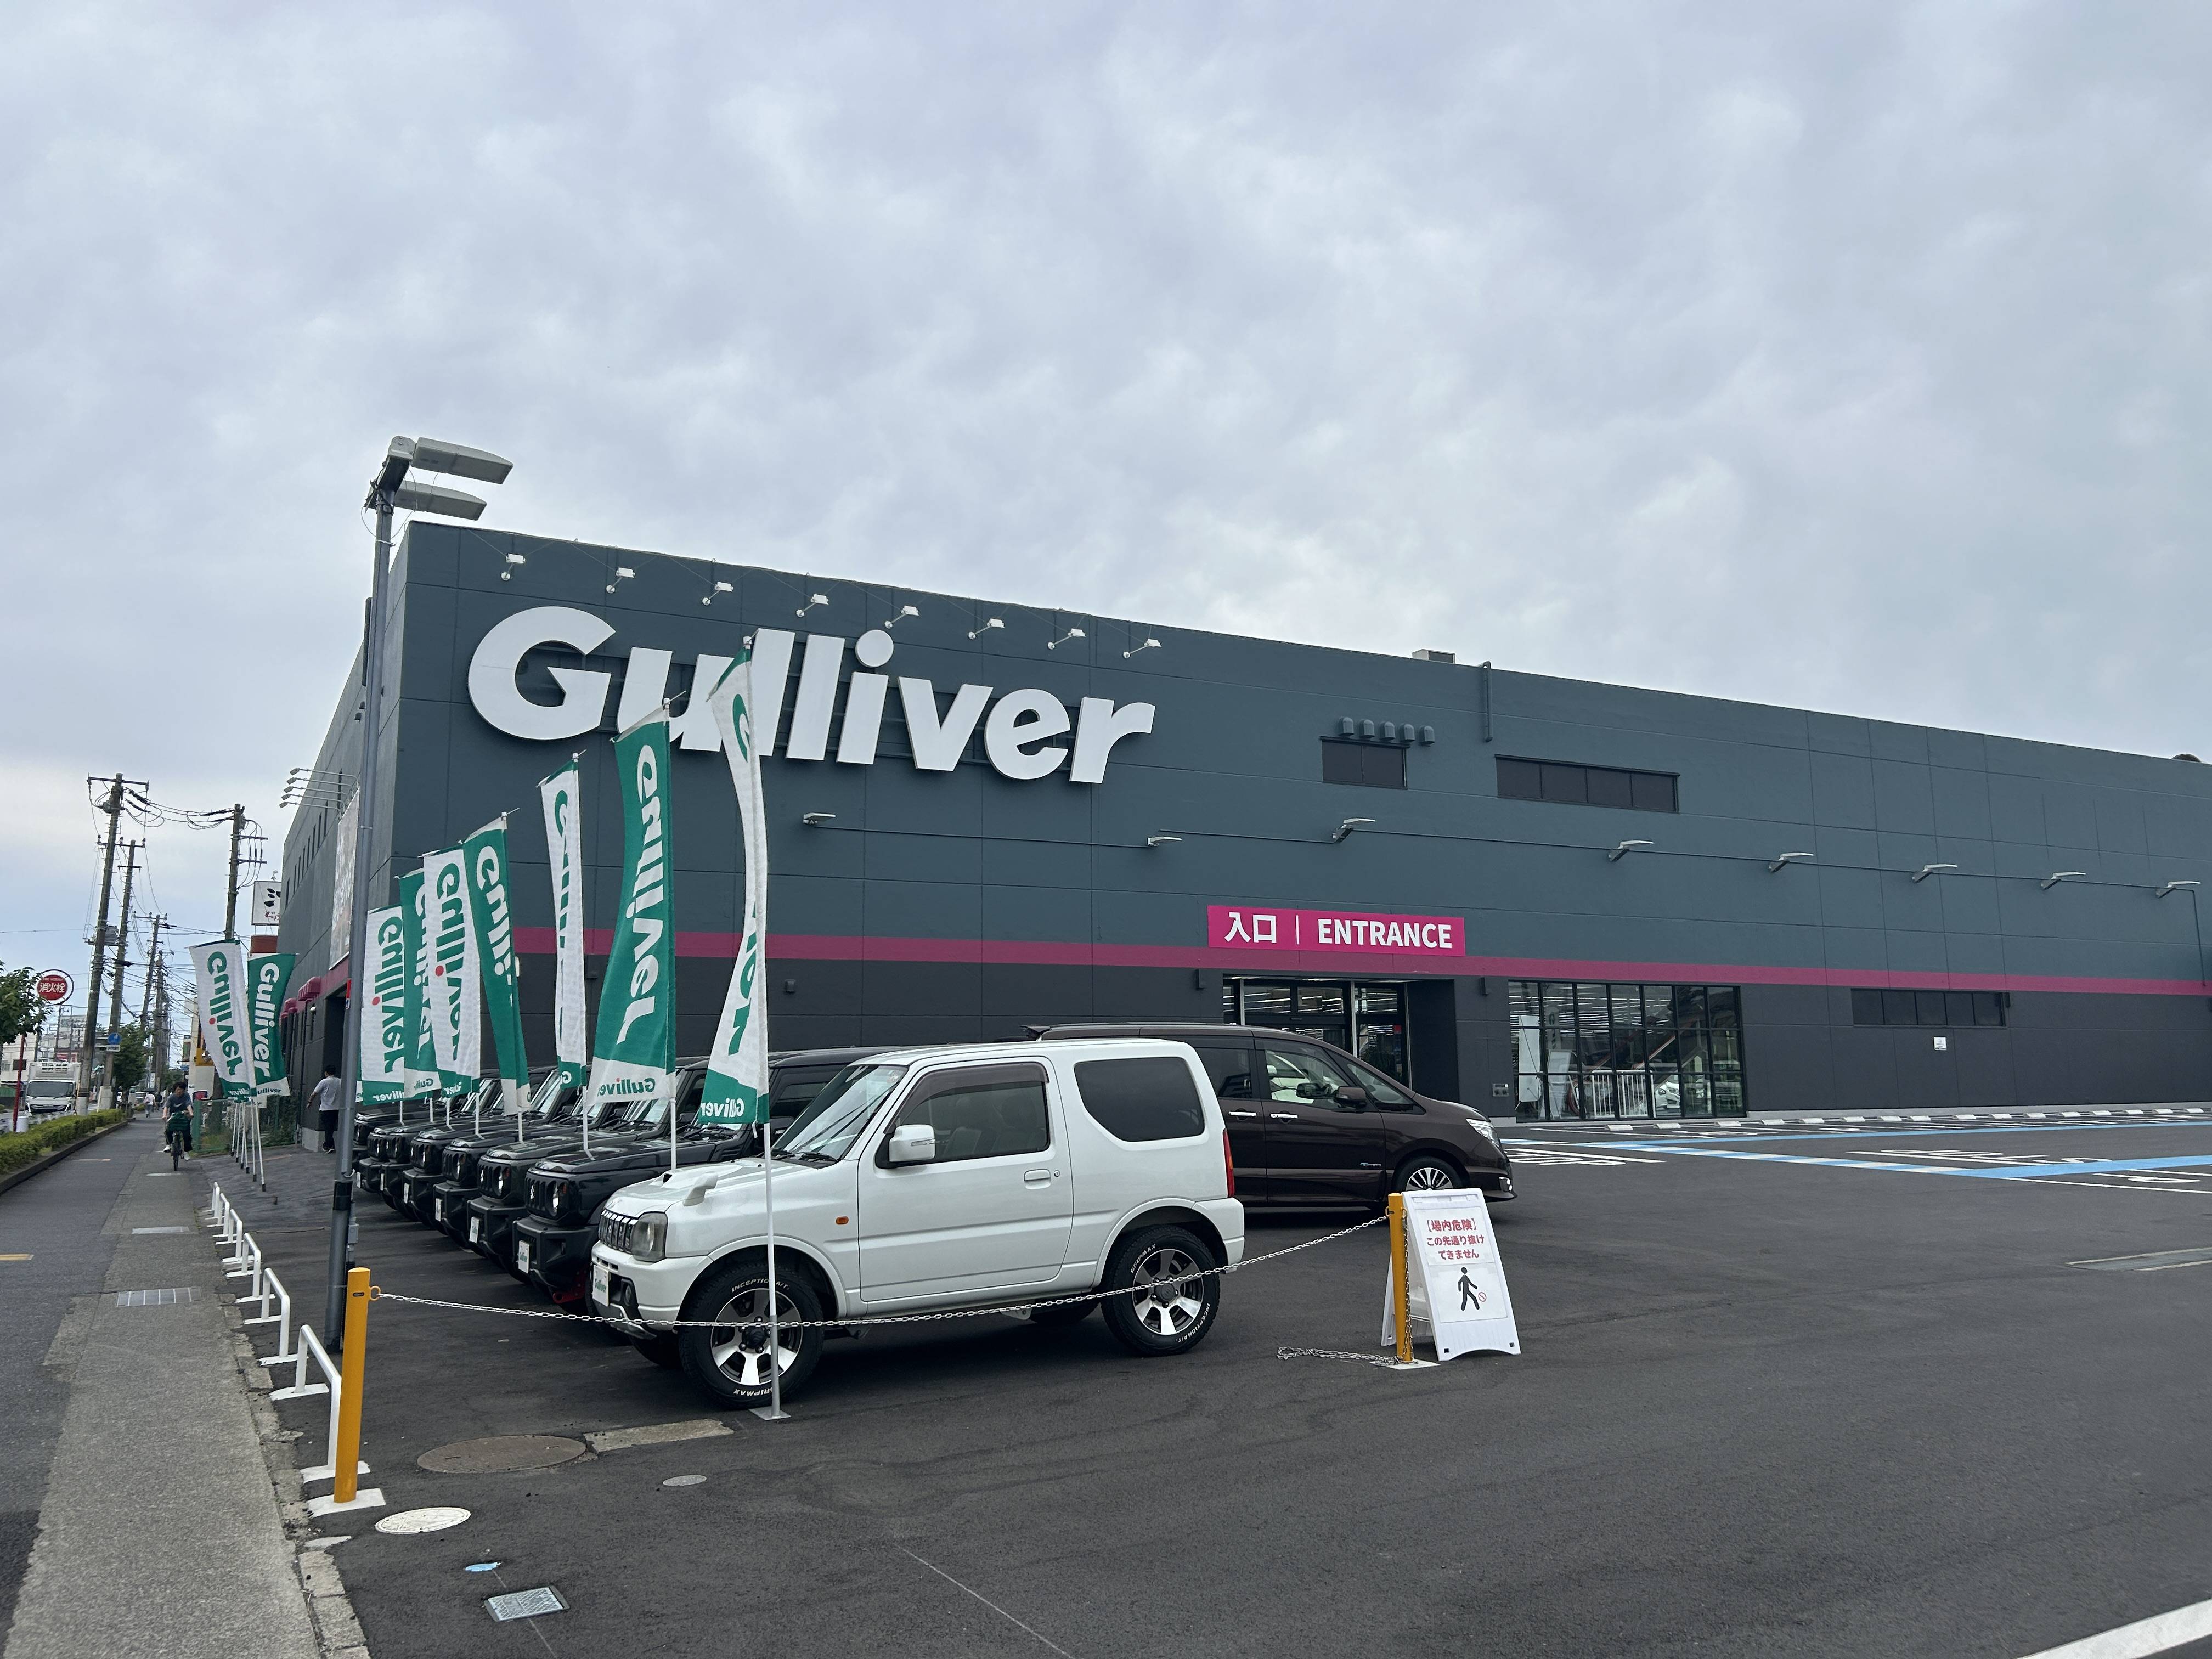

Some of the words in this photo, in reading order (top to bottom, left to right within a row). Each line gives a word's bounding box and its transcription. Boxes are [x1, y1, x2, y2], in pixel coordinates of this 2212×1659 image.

[467, 606, 1156, 784] Gulliver
[1224, 912, 1277, 944] 入口
[1318, 918, 1452, 949] ENTRANCE
[40, 982, 65, 992] 消火栓
[253, 962, 280, 1077] Gulliver
[1426, 1218, 1477, 1232] 【場内危険】
[1426, 1234, 1485, 1246] この先通り抜け
[1131, 1243, 1156, 1273] GRIPMAX
[1438, 1249, 1479, 1260] できません
[731, 1278, 770, 1293] INCEPTIO
